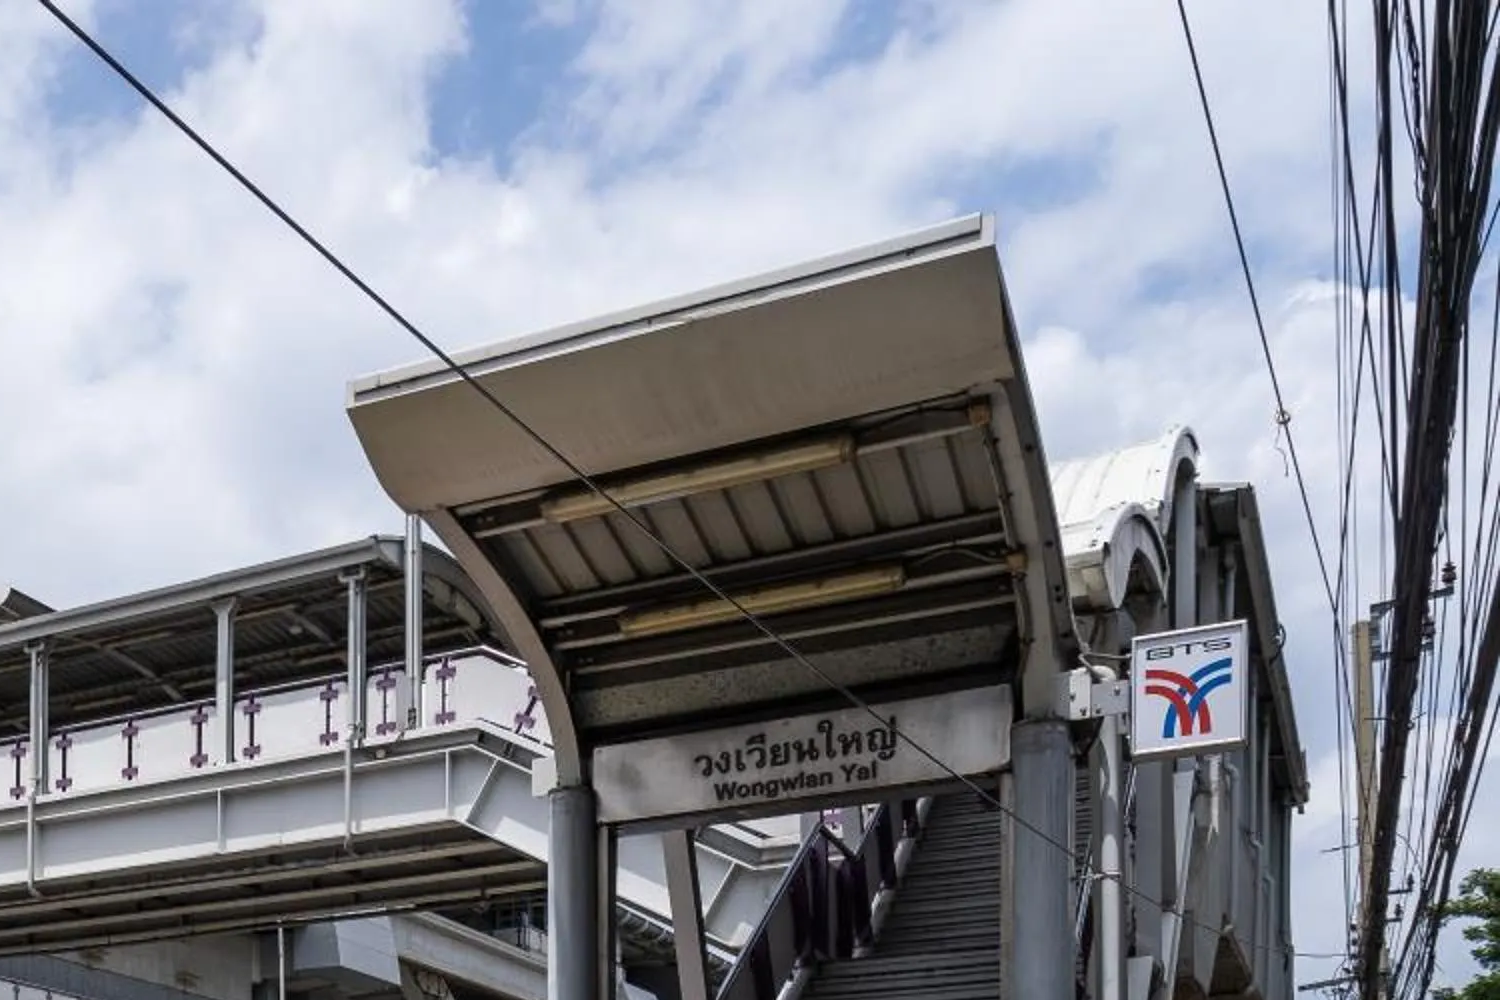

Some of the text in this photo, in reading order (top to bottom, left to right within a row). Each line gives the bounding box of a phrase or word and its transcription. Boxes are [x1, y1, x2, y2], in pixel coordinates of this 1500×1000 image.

[1146, 637, 1232, 661] BTS
[694, 716, 897, 777] วงเวียนใหญ่
[714, 760, 878, 801] Wongwian Yai
